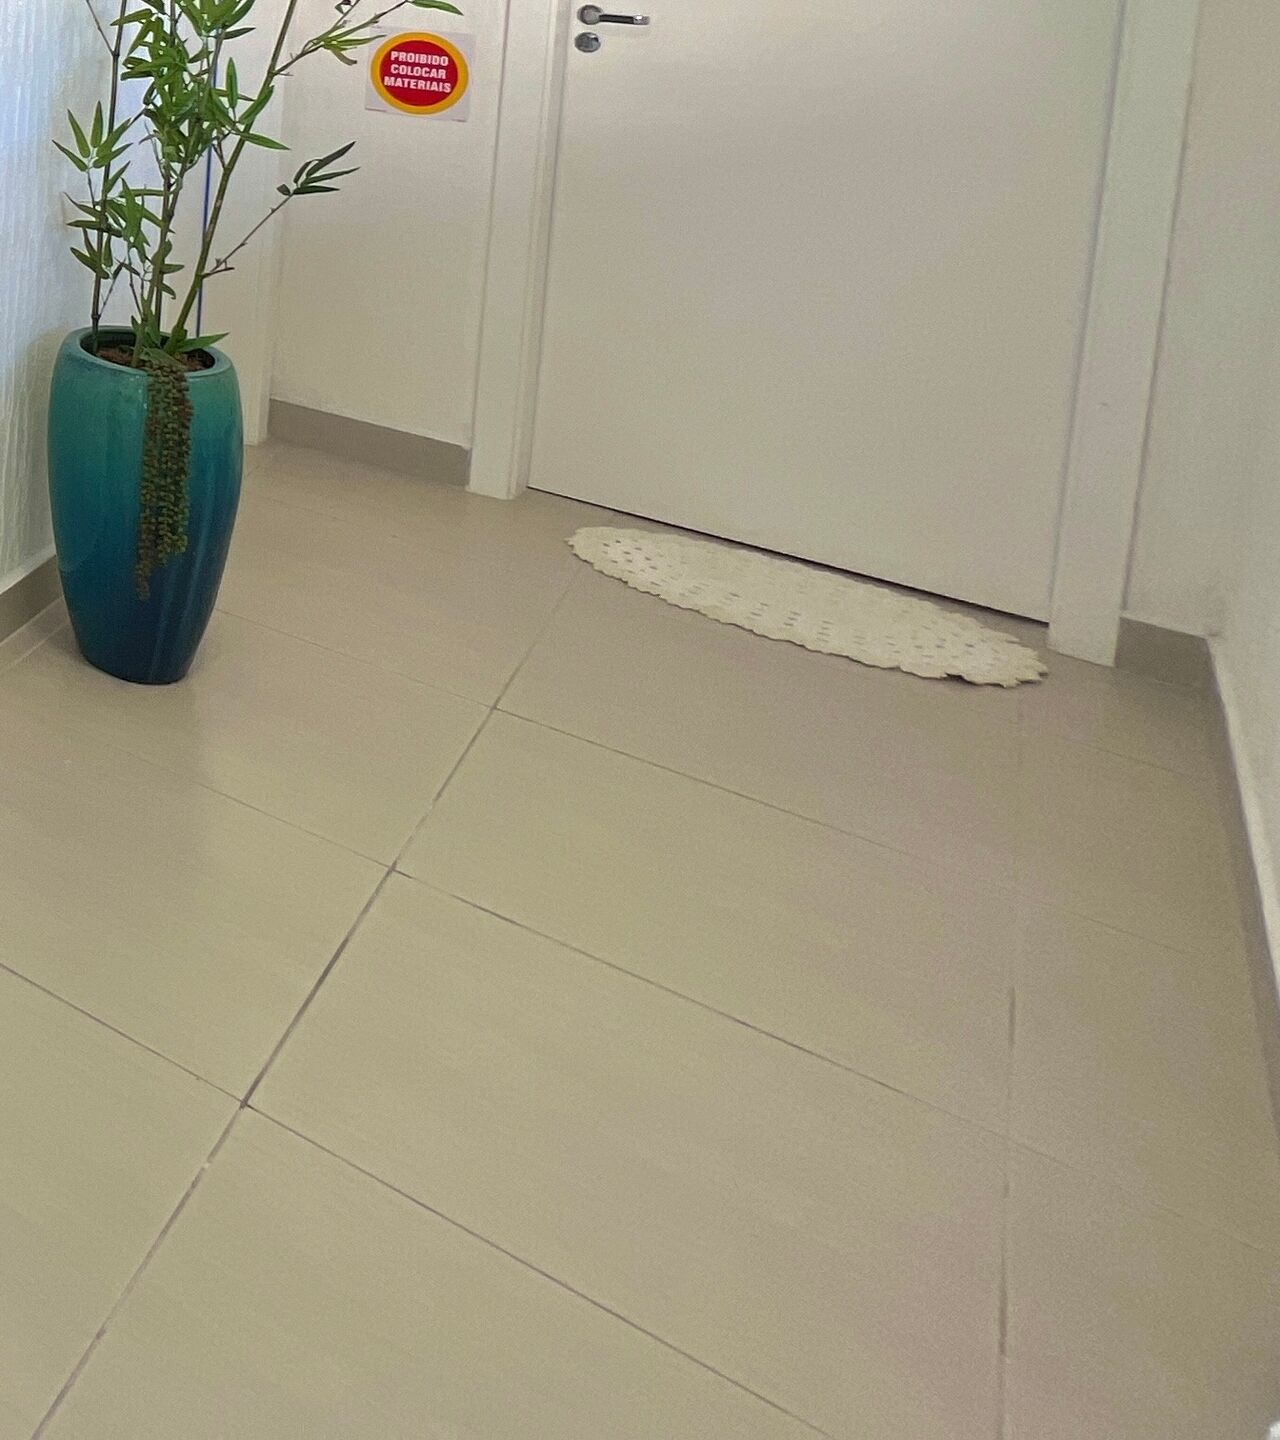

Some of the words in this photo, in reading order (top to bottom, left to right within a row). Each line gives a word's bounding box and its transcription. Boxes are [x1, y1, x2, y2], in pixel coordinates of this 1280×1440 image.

[390, 51, 449, 67] PROIBIDO
[390, 64, 447, 79] COLOCAR
[383, 76, 452, 94] MATERIAIS
